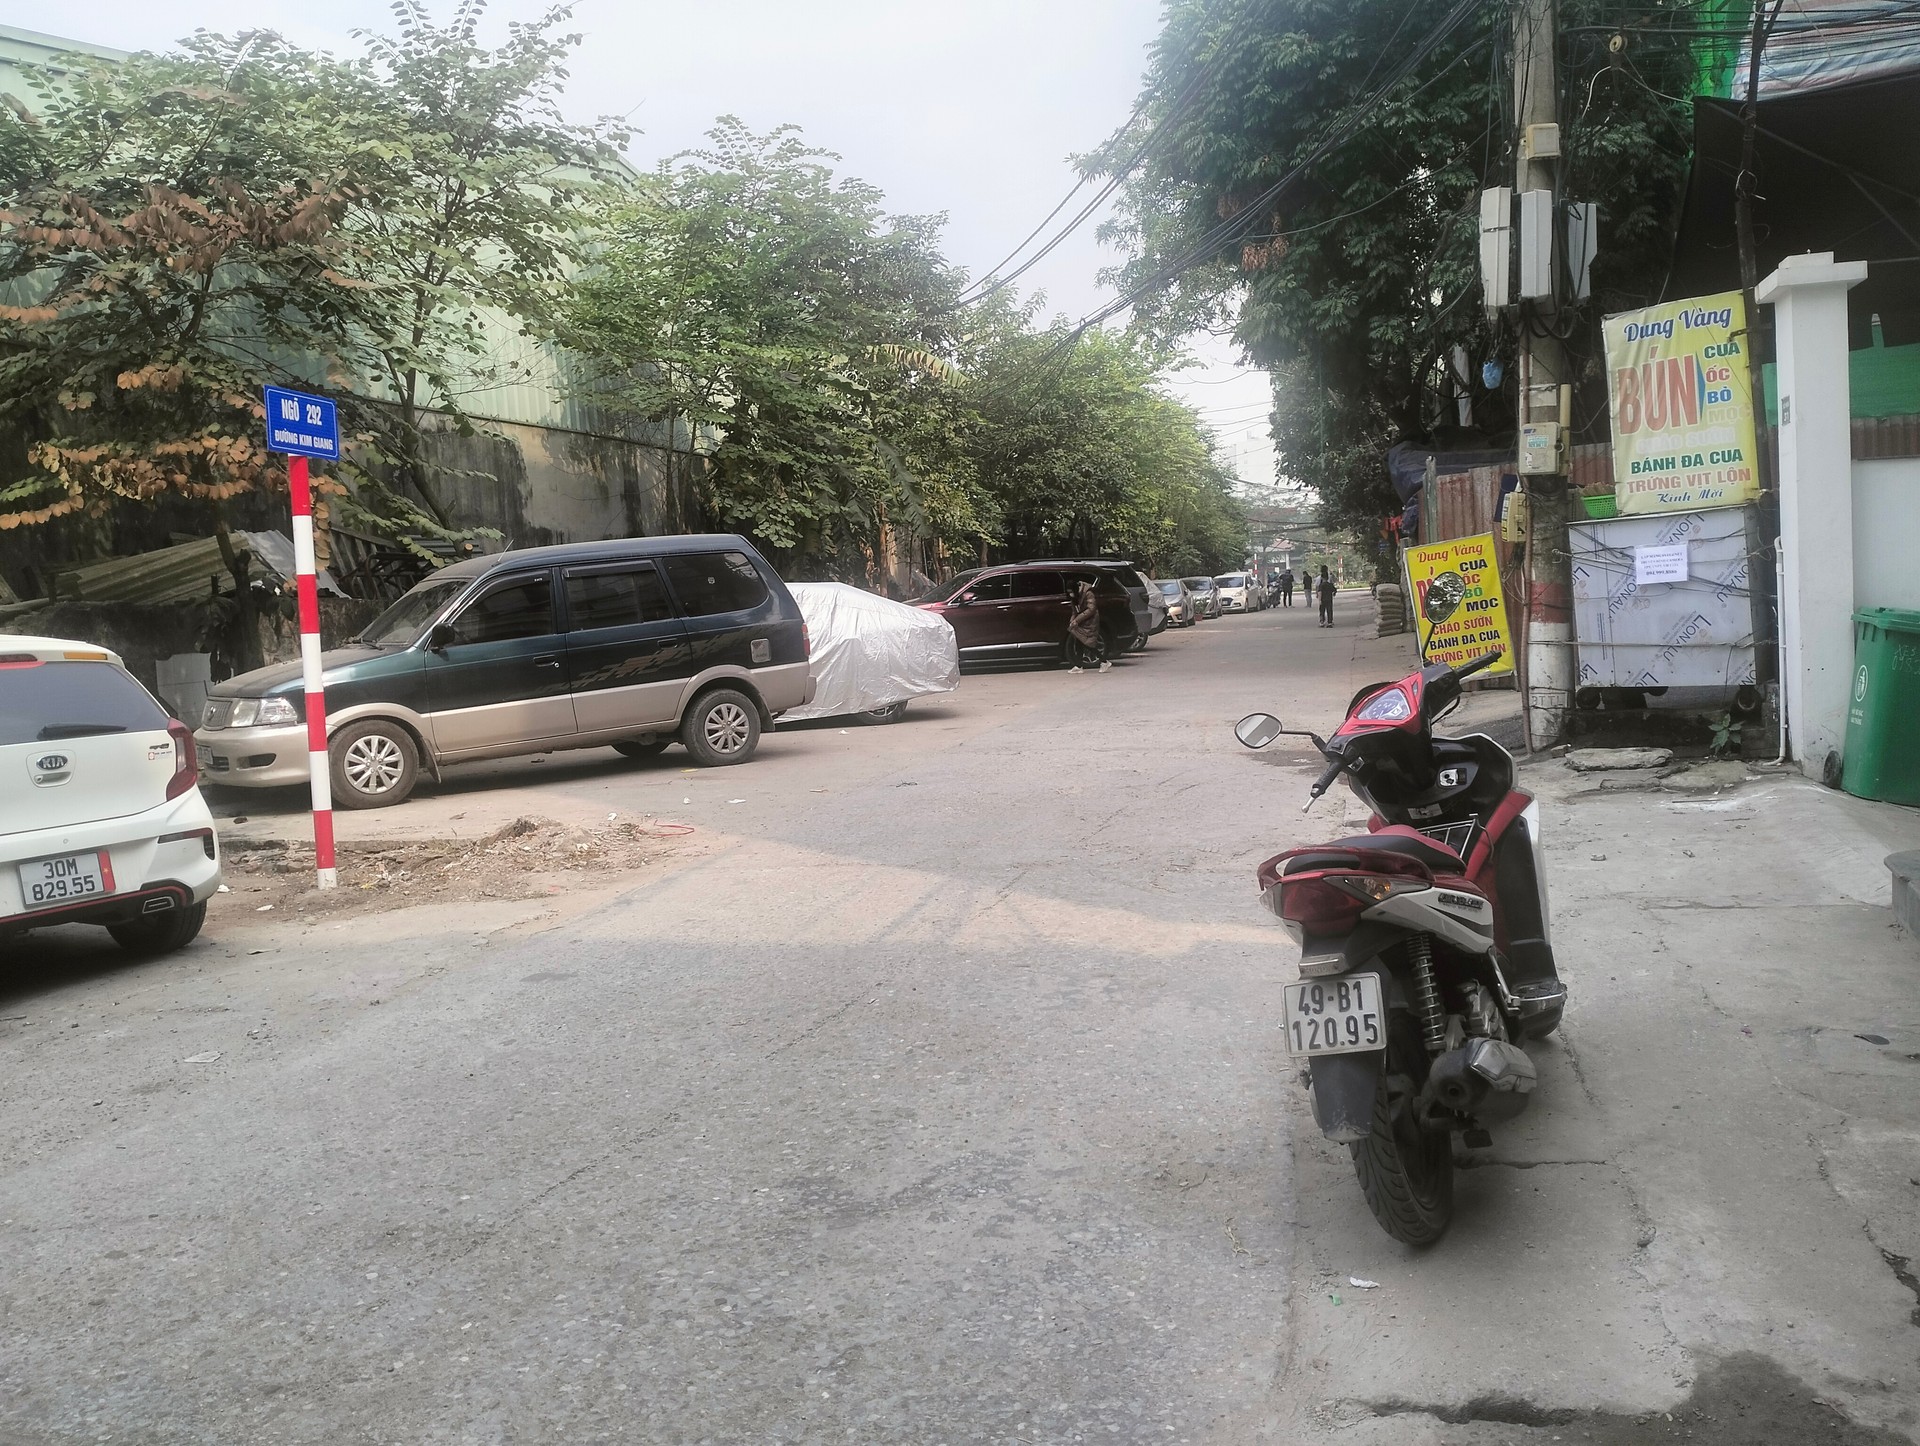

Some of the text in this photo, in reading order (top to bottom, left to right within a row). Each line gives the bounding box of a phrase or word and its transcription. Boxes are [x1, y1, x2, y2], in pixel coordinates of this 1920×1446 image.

[1624, 307, 1732, 343] Dung Vàng
[1703, 341, 1741, 359] CUA
[1706, 365, 1731, 383] ỐC
[1617, 345, 1698, 435] BÚN
[1707, 386, 1732, 404] BÒ
[281, 397, 322, 425] NGÕ 292
[274, 428, 333, 450] ĐƯỜNG KIM GIANG
[1631, 448, 1743, 474] BÁNH ĐA CUA
[1627, 466, 1751, 494] TRỨNG VỊT LỘN
[1417, 544, 1483, 563] Dung Vàng
[1459, 558, 1488, 572] CUA
[1716, 564, 1749, 603] ONALU
[1466, 597, 1499, 612] MỌC
[1433, 615, 1493, 636] CHÁO SƯỜN
[1430, 630, 1500, 651] BÁNH ĐA CUA
[42, 757, 64, 769] KIA
[42, 858, 78, 879] 30M
[32, 875, 96, 902] 829.55
[1298, 981, 1363, 1016] 49-B1
[1292, 1013, 1378, 1051] 120.95
